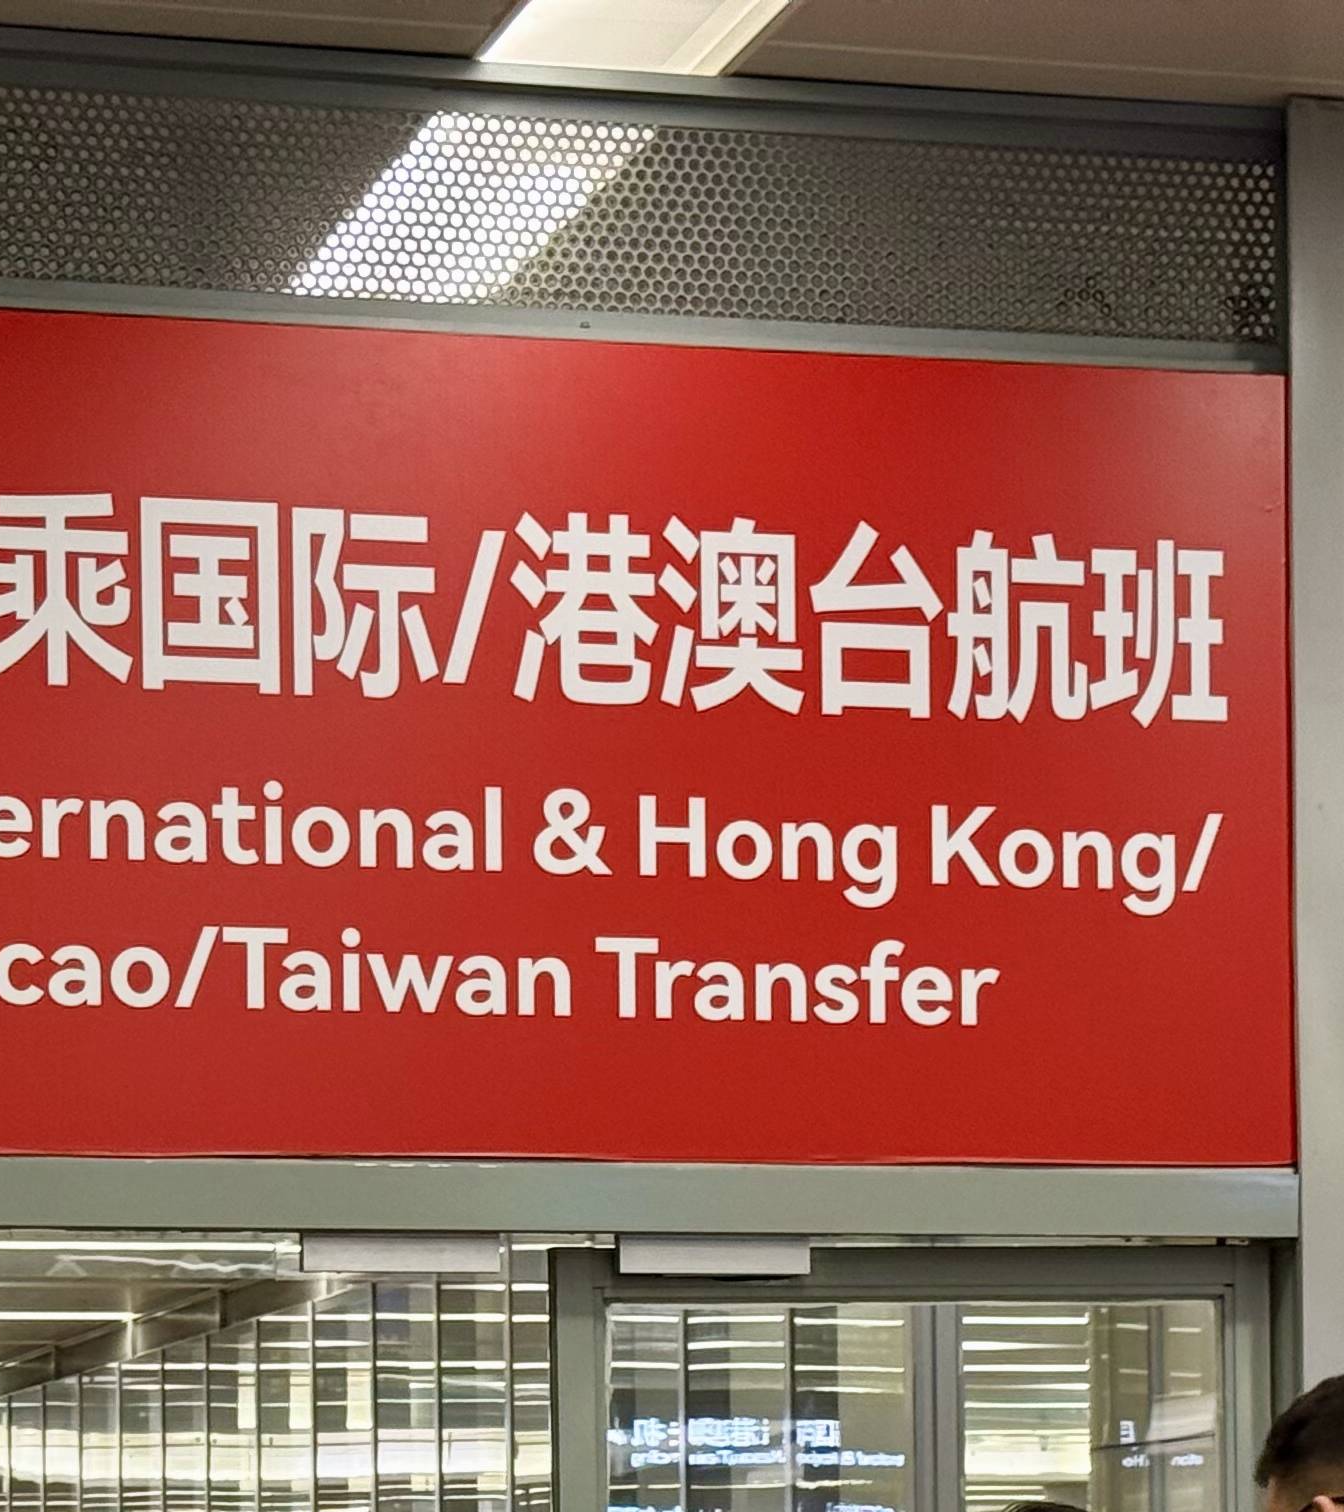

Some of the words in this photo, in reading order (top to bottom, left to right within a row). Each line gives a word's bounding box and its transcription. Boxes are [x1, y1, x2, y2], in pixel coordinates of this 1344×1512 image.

[532, 787, 612, 876] &
[638, 794, 898, 909] Hong
[930, 804, 1224, 917] Kong/
[594, 936, 1000, 1026] Transfer
